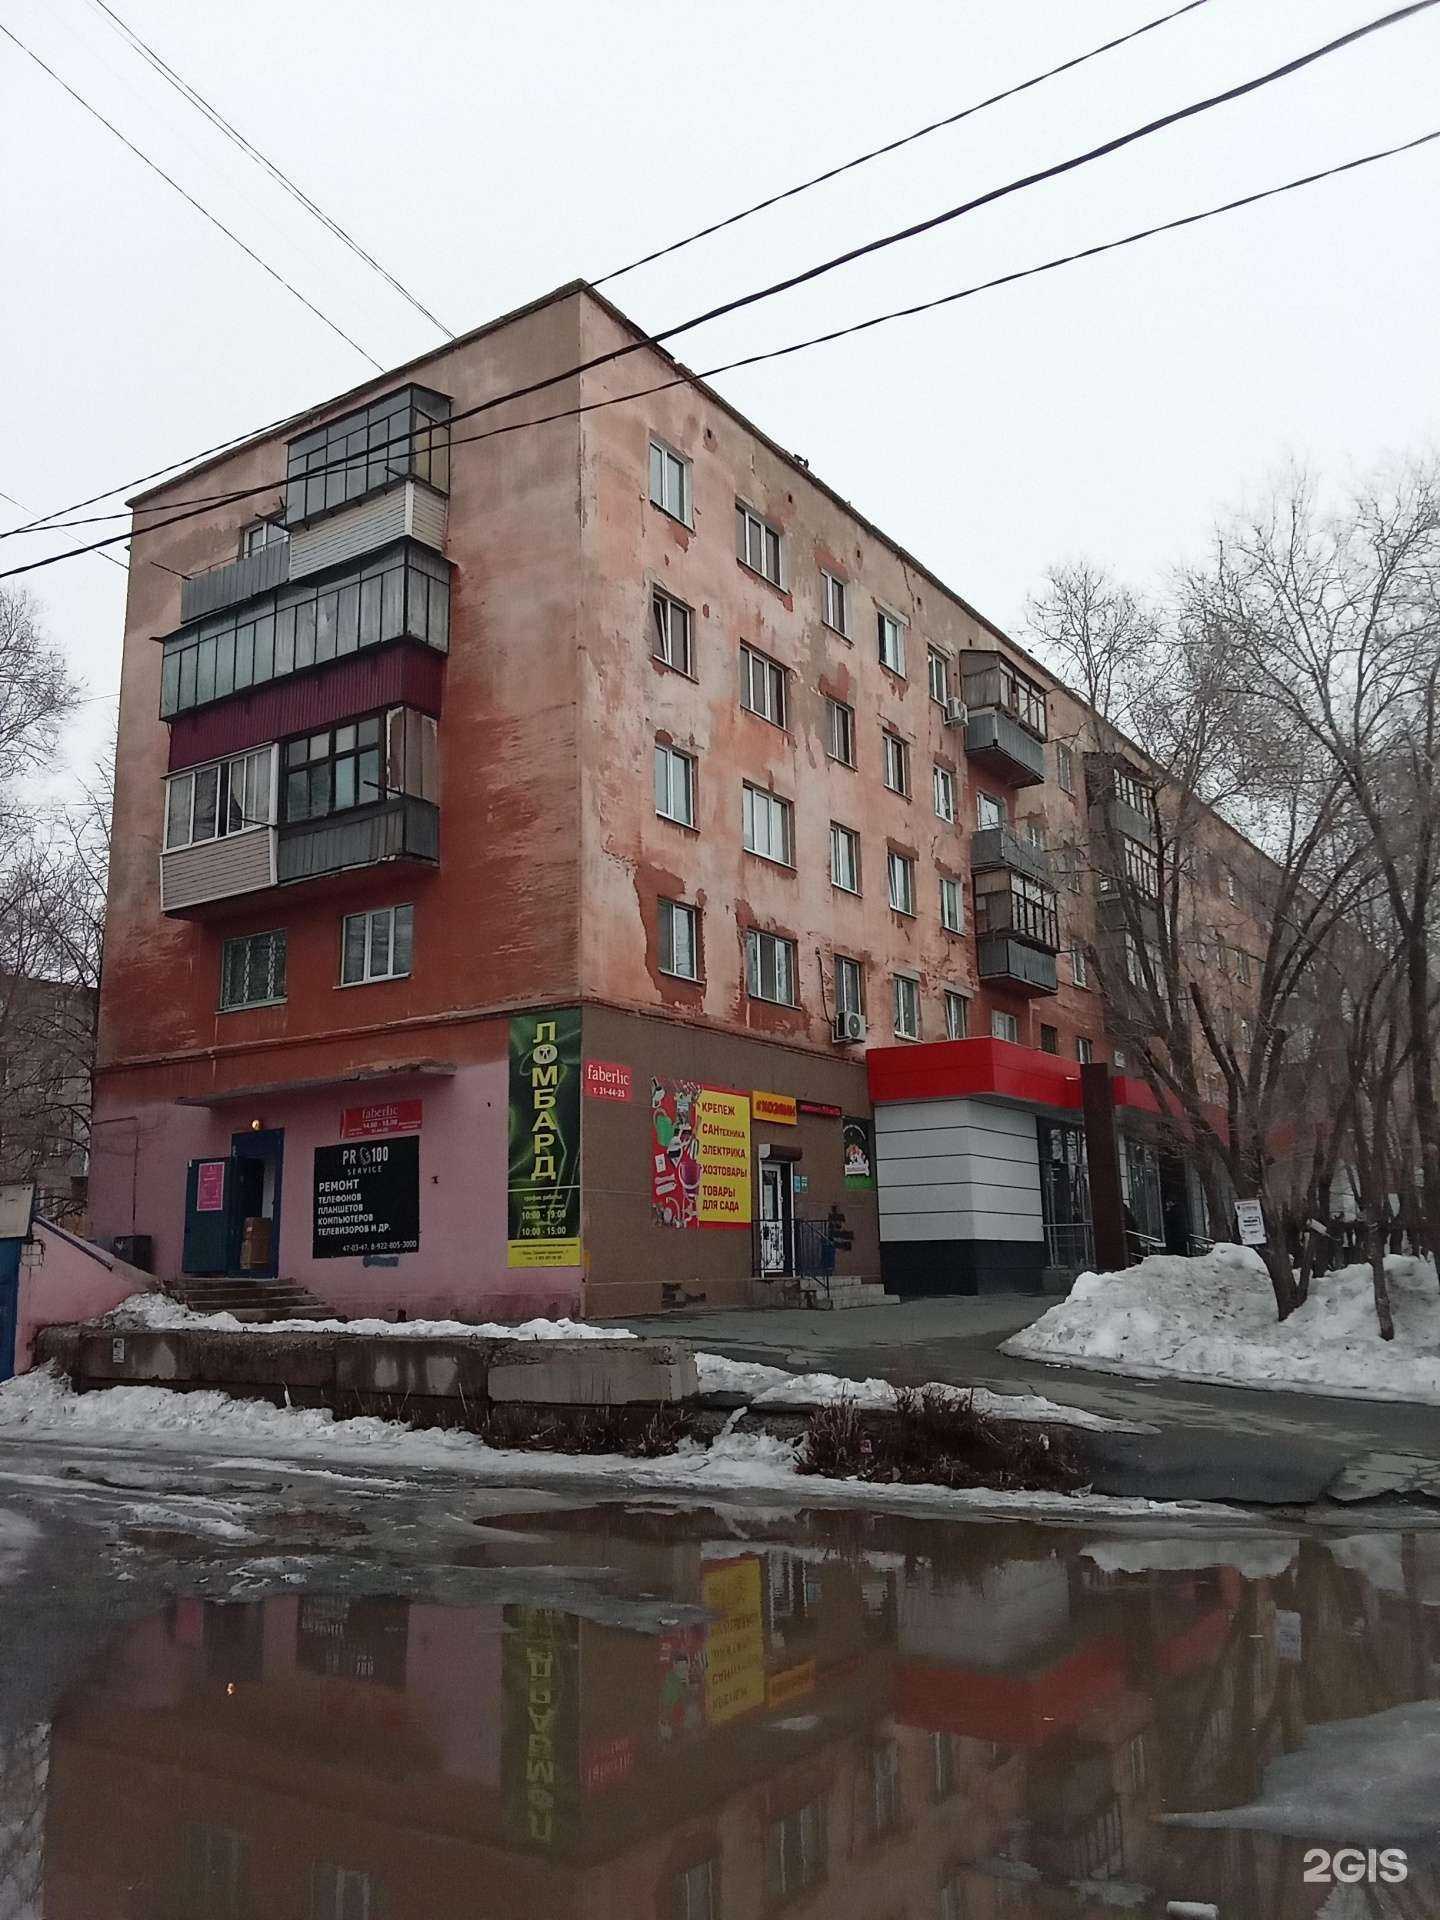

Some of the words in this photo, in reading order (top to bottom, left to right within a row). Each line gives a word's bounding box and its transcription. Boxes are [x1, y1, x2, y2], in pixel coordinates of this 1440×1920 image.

[588, 1064, 630, 1086] faberlic
[531, 1021, 558, 1182] ЛОМБАРД
[361, 1104, 400, 1120] faberlic
[701, 1101, 736, 1117] КРЕПЕЖ
[702, 1144, 746, 1159] ЭЛЕКТРИКА
[347, 1165, 383, 1176] SERVICE
[702, 1163, 748, 1178] ХОЗТОВАРЫ
[318, 1178, 360, 1193] РЕМОНТ
[702, 1185, 736, 1198] ТОВАРЫ
[318, 1193, 362, 1204] ТЕЛЕФОНОВ
[318, 1203, 364, 1215] ПЛАНШЕТОВ
[702, 1199, 718, 1211] ДЛЯ
[719, 1200, 739, 1213] САДА
[318, 1213, 374, 1226] КОМПЬЮТЕРОВ
[318, 1224, 369, 1236] ТЕЛЕВИЗОРОВ
[377, 1223, 391, 1233] ДР.
